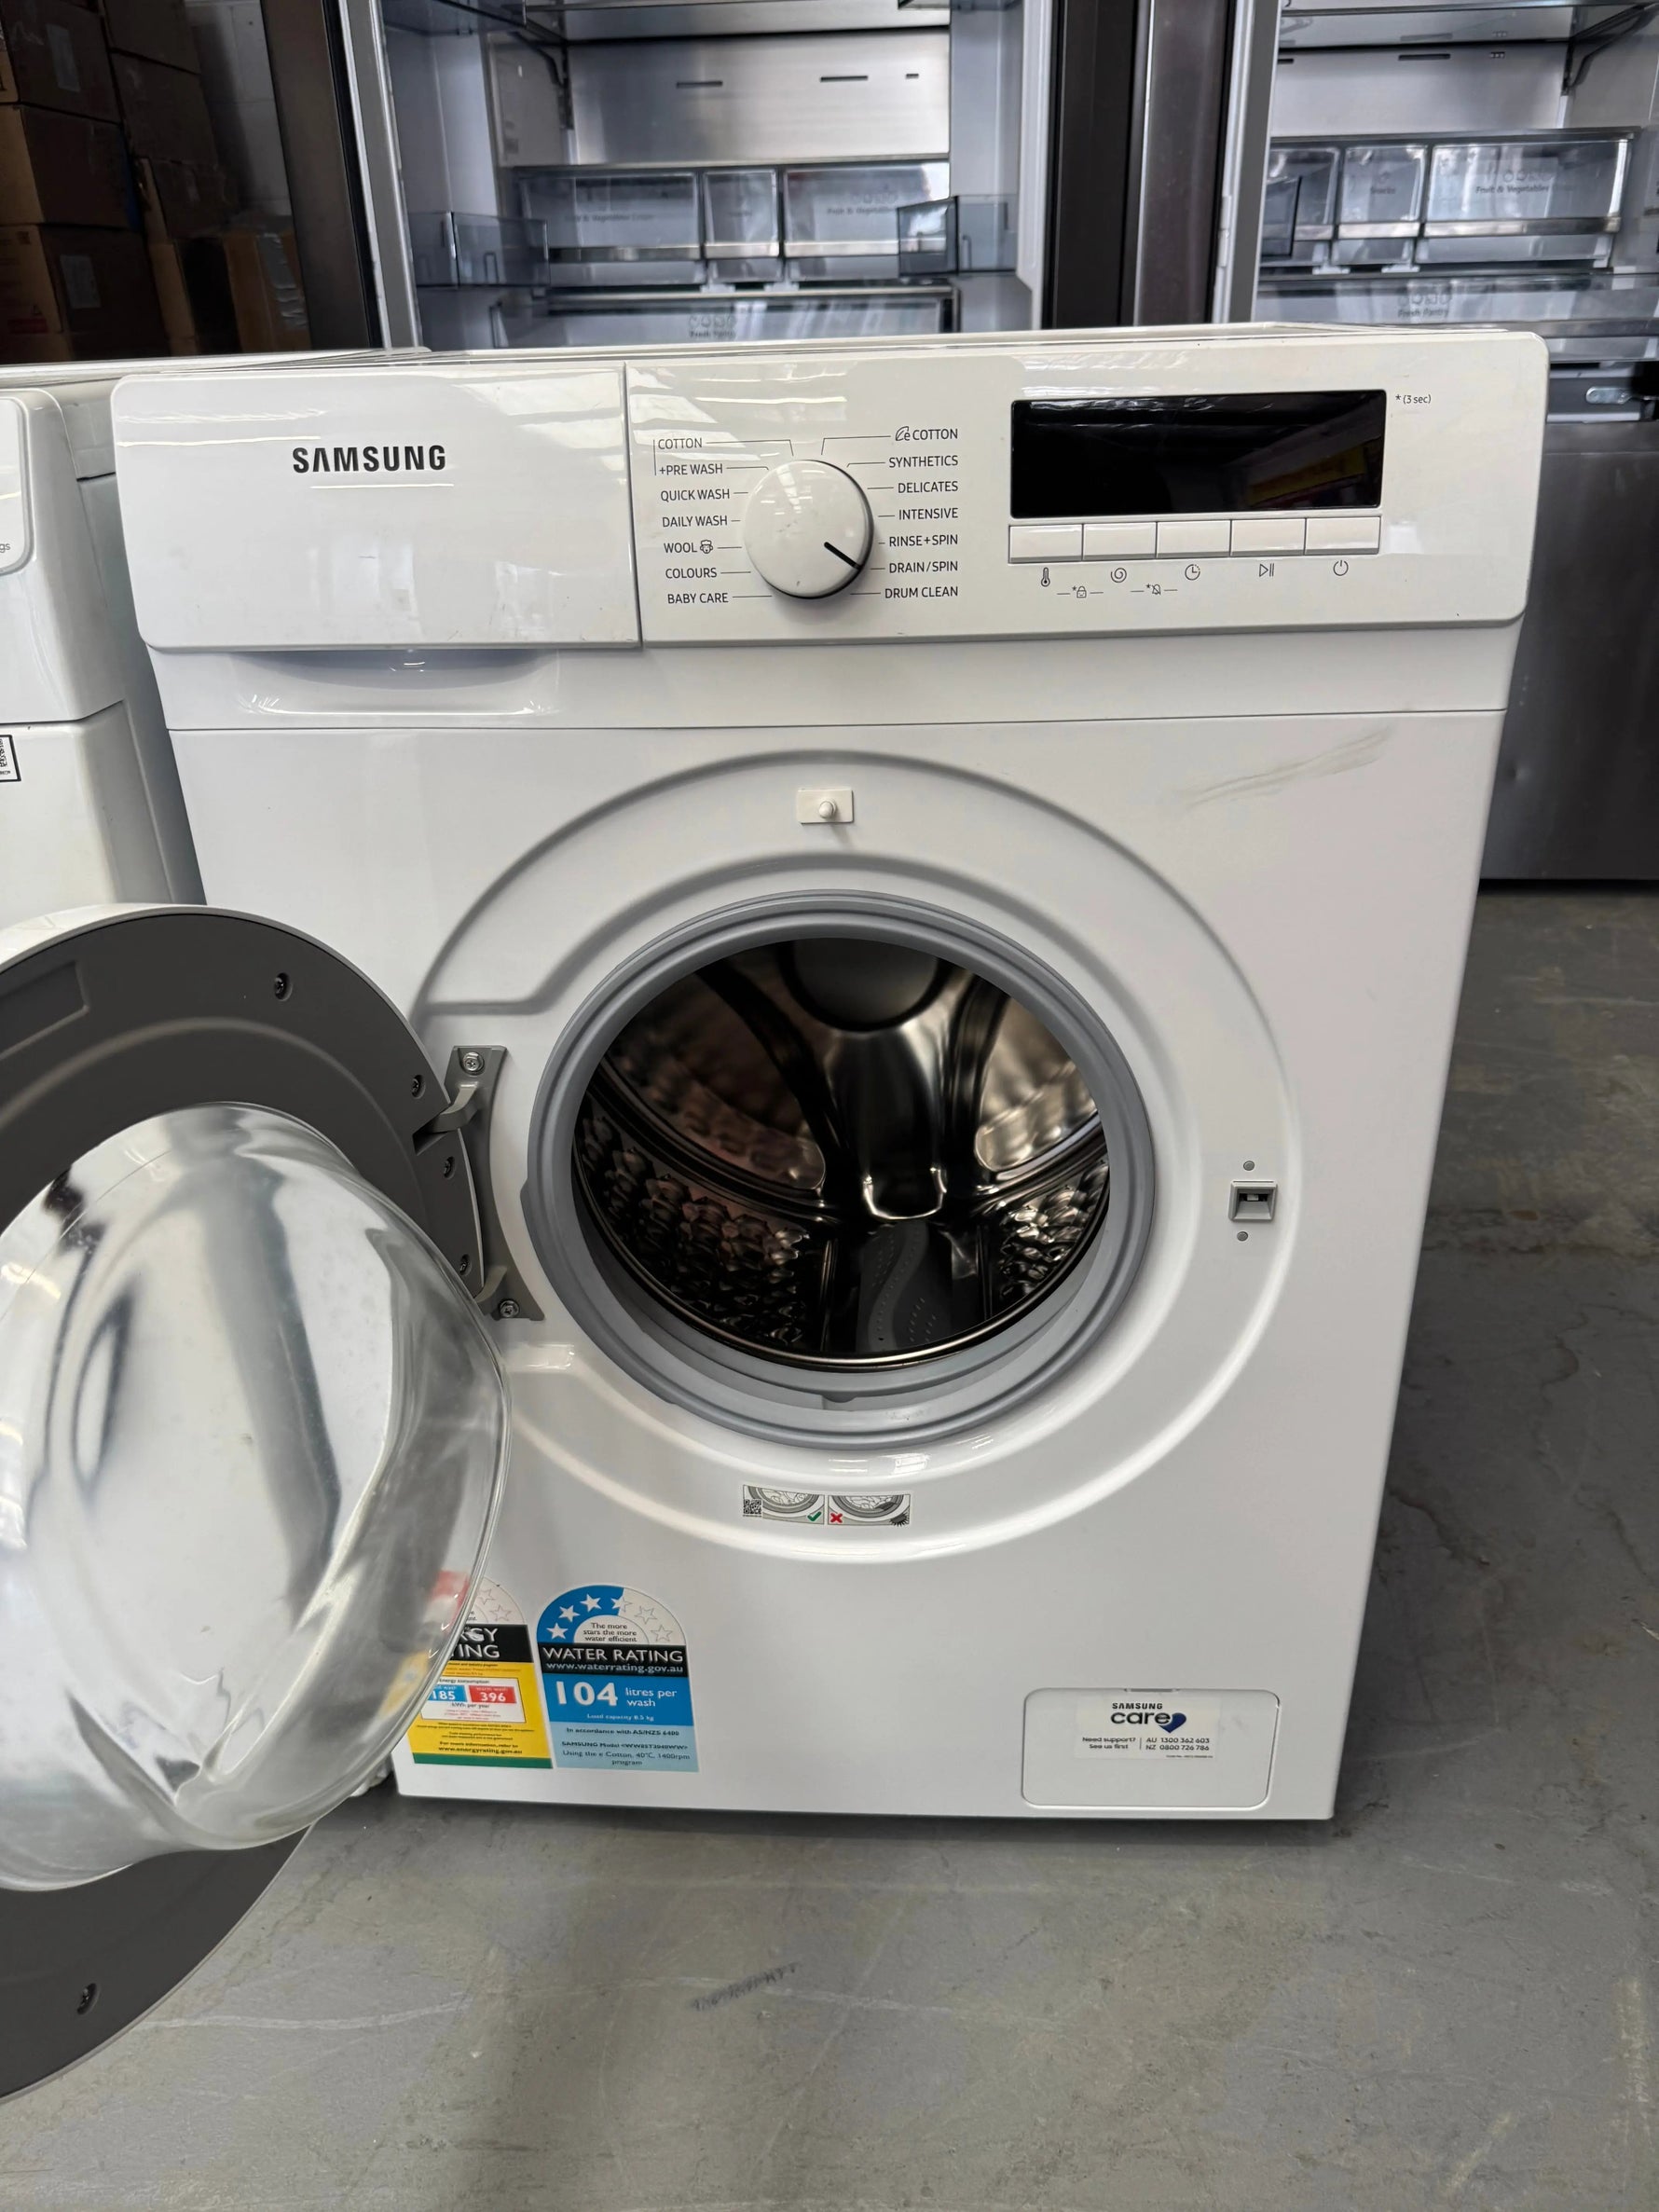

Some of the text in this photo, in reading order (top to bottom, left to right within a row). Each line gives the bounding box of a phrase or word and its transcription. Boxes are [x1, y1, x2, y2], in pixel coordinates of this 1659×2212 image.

[1403, 393, 1432, 405] (3 sec)
[912, 429, 958, 441] COTTON
[657, 437, 703, 449] COTTON
[292, 445, 446, 474] SAMSUNG
[888, 455, 959, 468] SYNTHETICS
[659, 463, 723, 475] +PRE WASH
[898, 481, 959, 493] DELICATES
[661, 488, 730, 502] QUICK WASH
[898, 507, 959, 520] INTENSIVE
[662, 515, 728, 528] DAILY WASH
[664, 543, 698, 553] WOOL
[665, 567, 718, 579] COLOURS
[888, 561, 959, 574] DRAIN/SPIN
[667, 593, 729, 604] BABY CARE
[884, 586, 959, 599] DRUM CLEAN
[542, 1646, 683, 1663] WATER RATING
[546, 1662, 684, 1675] www.waterrating.gov.au
[432, 1690, 457, 1700] 185
[479, 1692, 507, 1702] 396
[556, 1681, 619, 1707] 104
[625, 1687, 678, 1700] litres per
[626, 1698, 656, 1707] wash
[1110, 1711, 1172, 1724] care
[562, 1750, 583, 1758] Using
